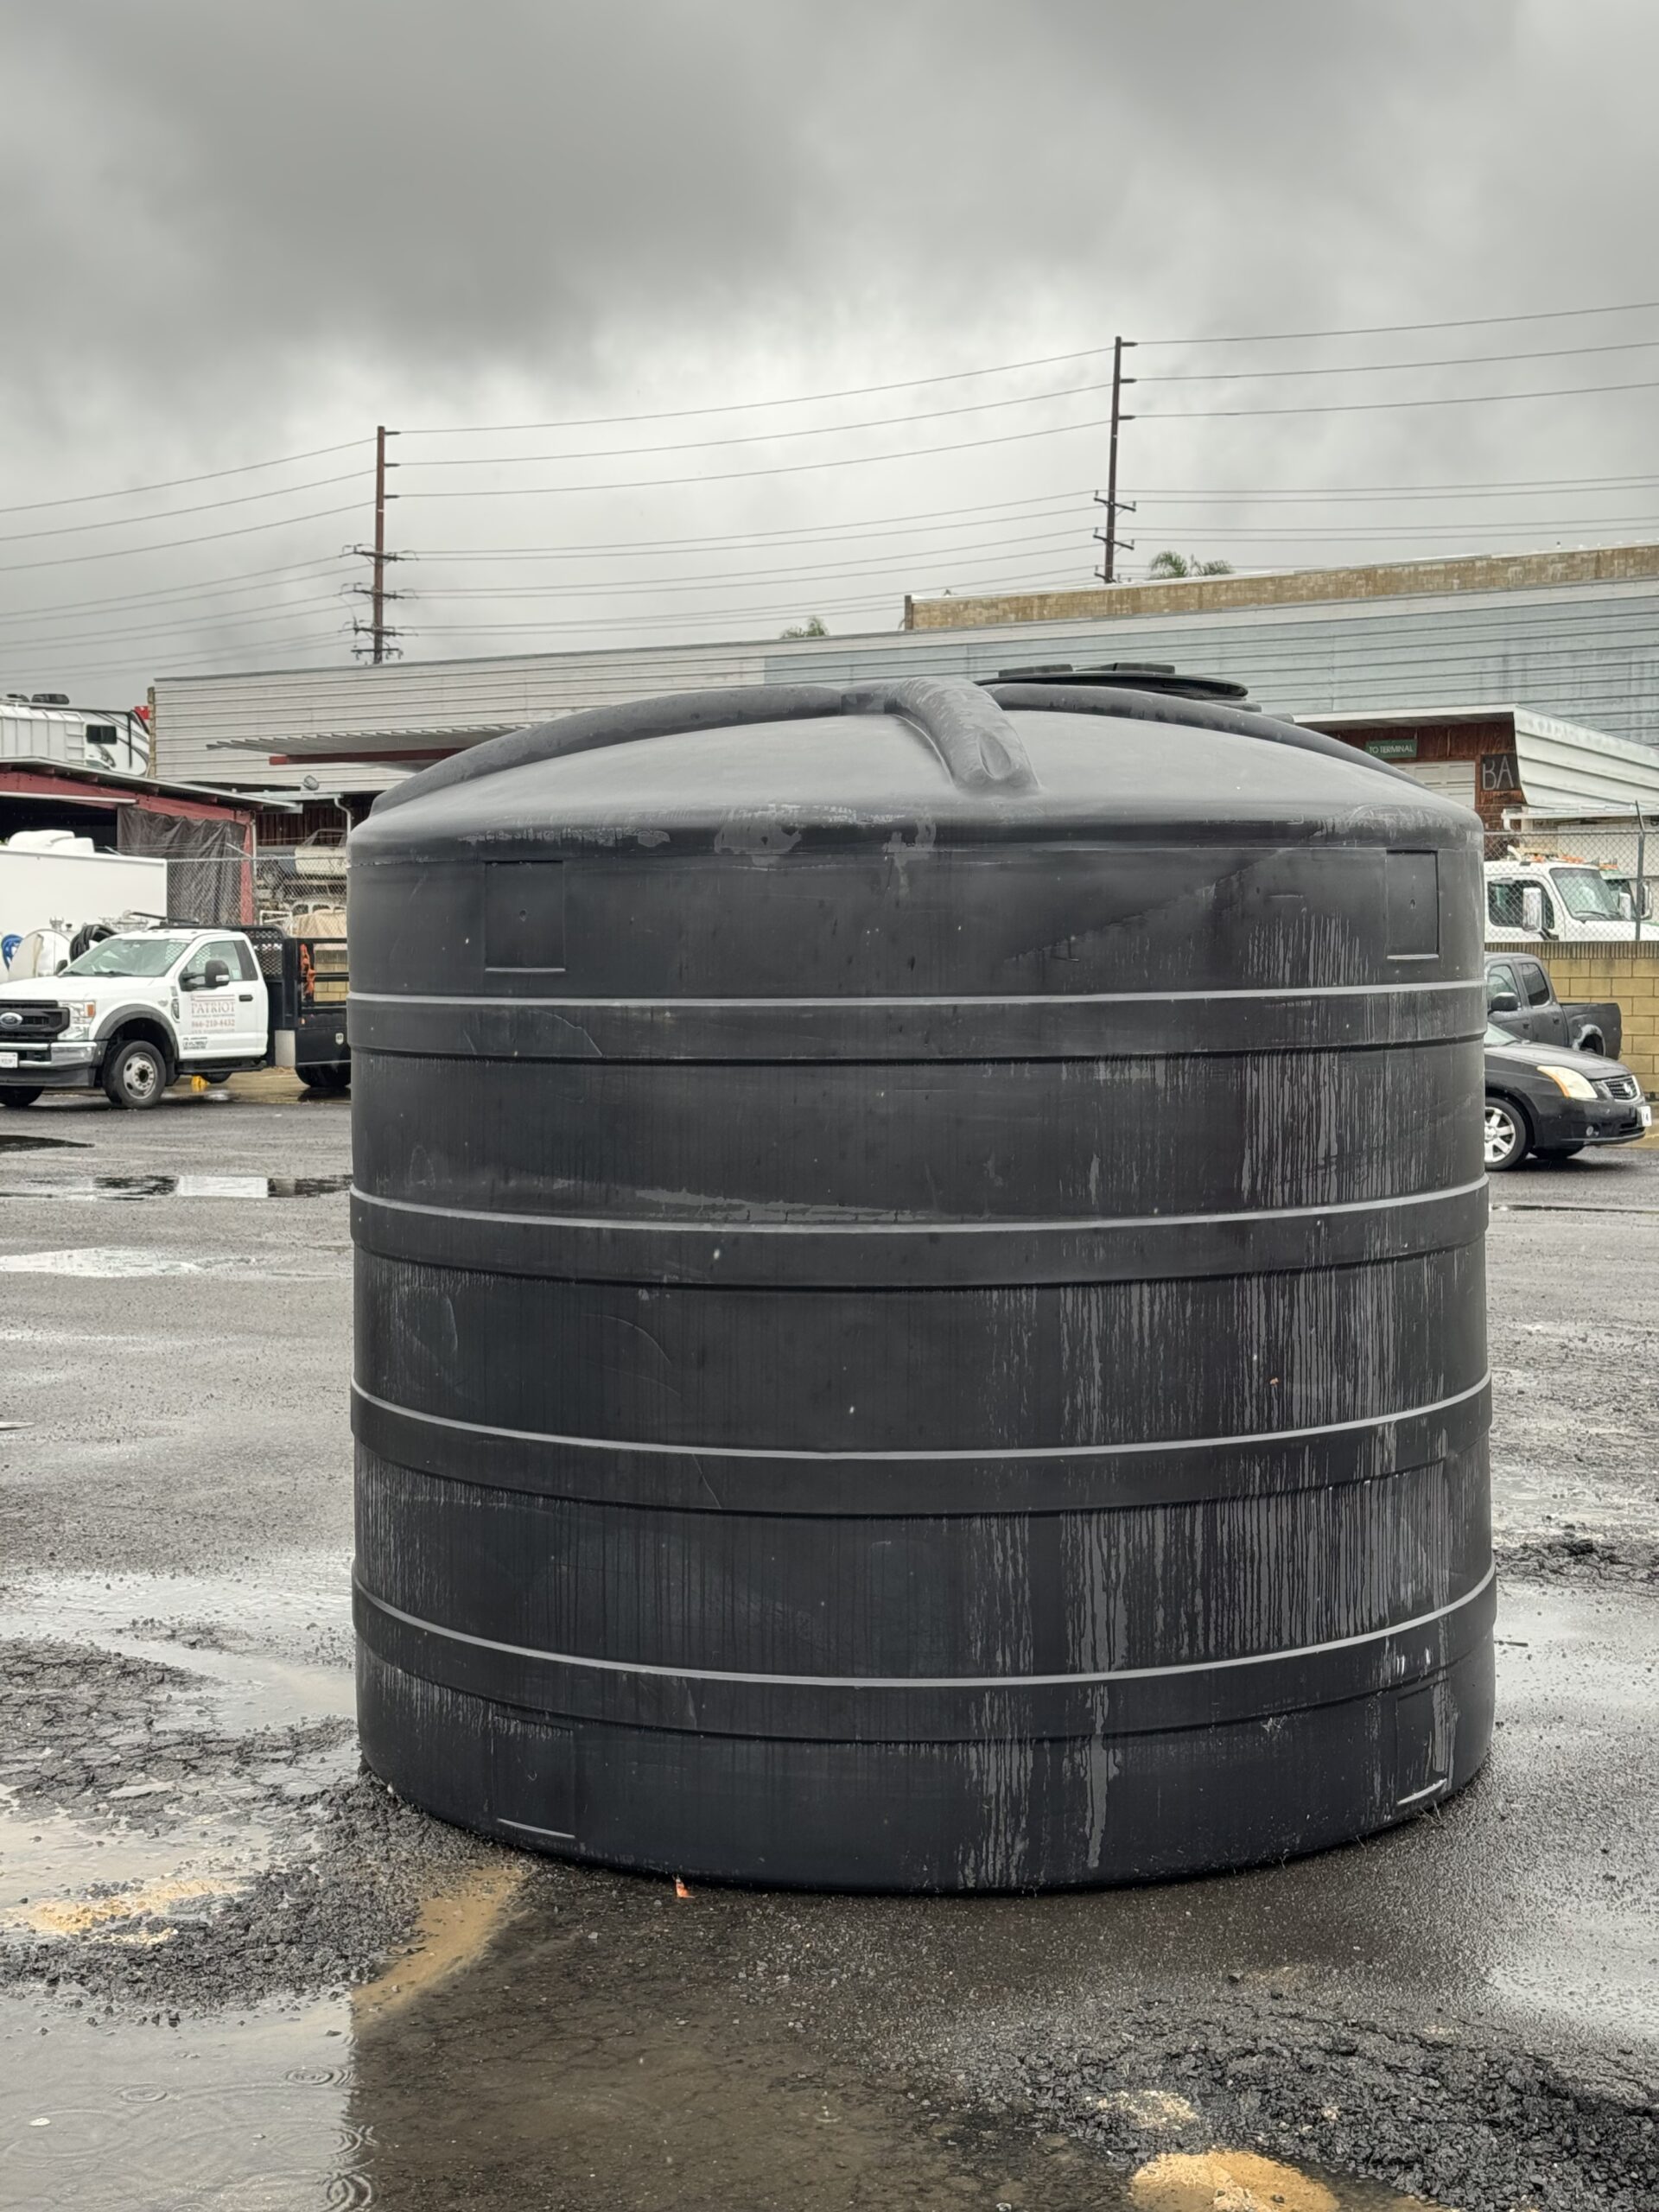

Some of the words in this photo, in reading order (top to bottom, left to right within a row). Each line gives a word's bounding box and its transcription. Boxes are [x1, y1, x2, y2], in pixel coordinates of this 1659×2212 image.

[1369, 746, 1379, 754] TO
[1380, 744, 1414, 753] TERMINAL
[191, 1001, 235, 1014] PATRIOT
